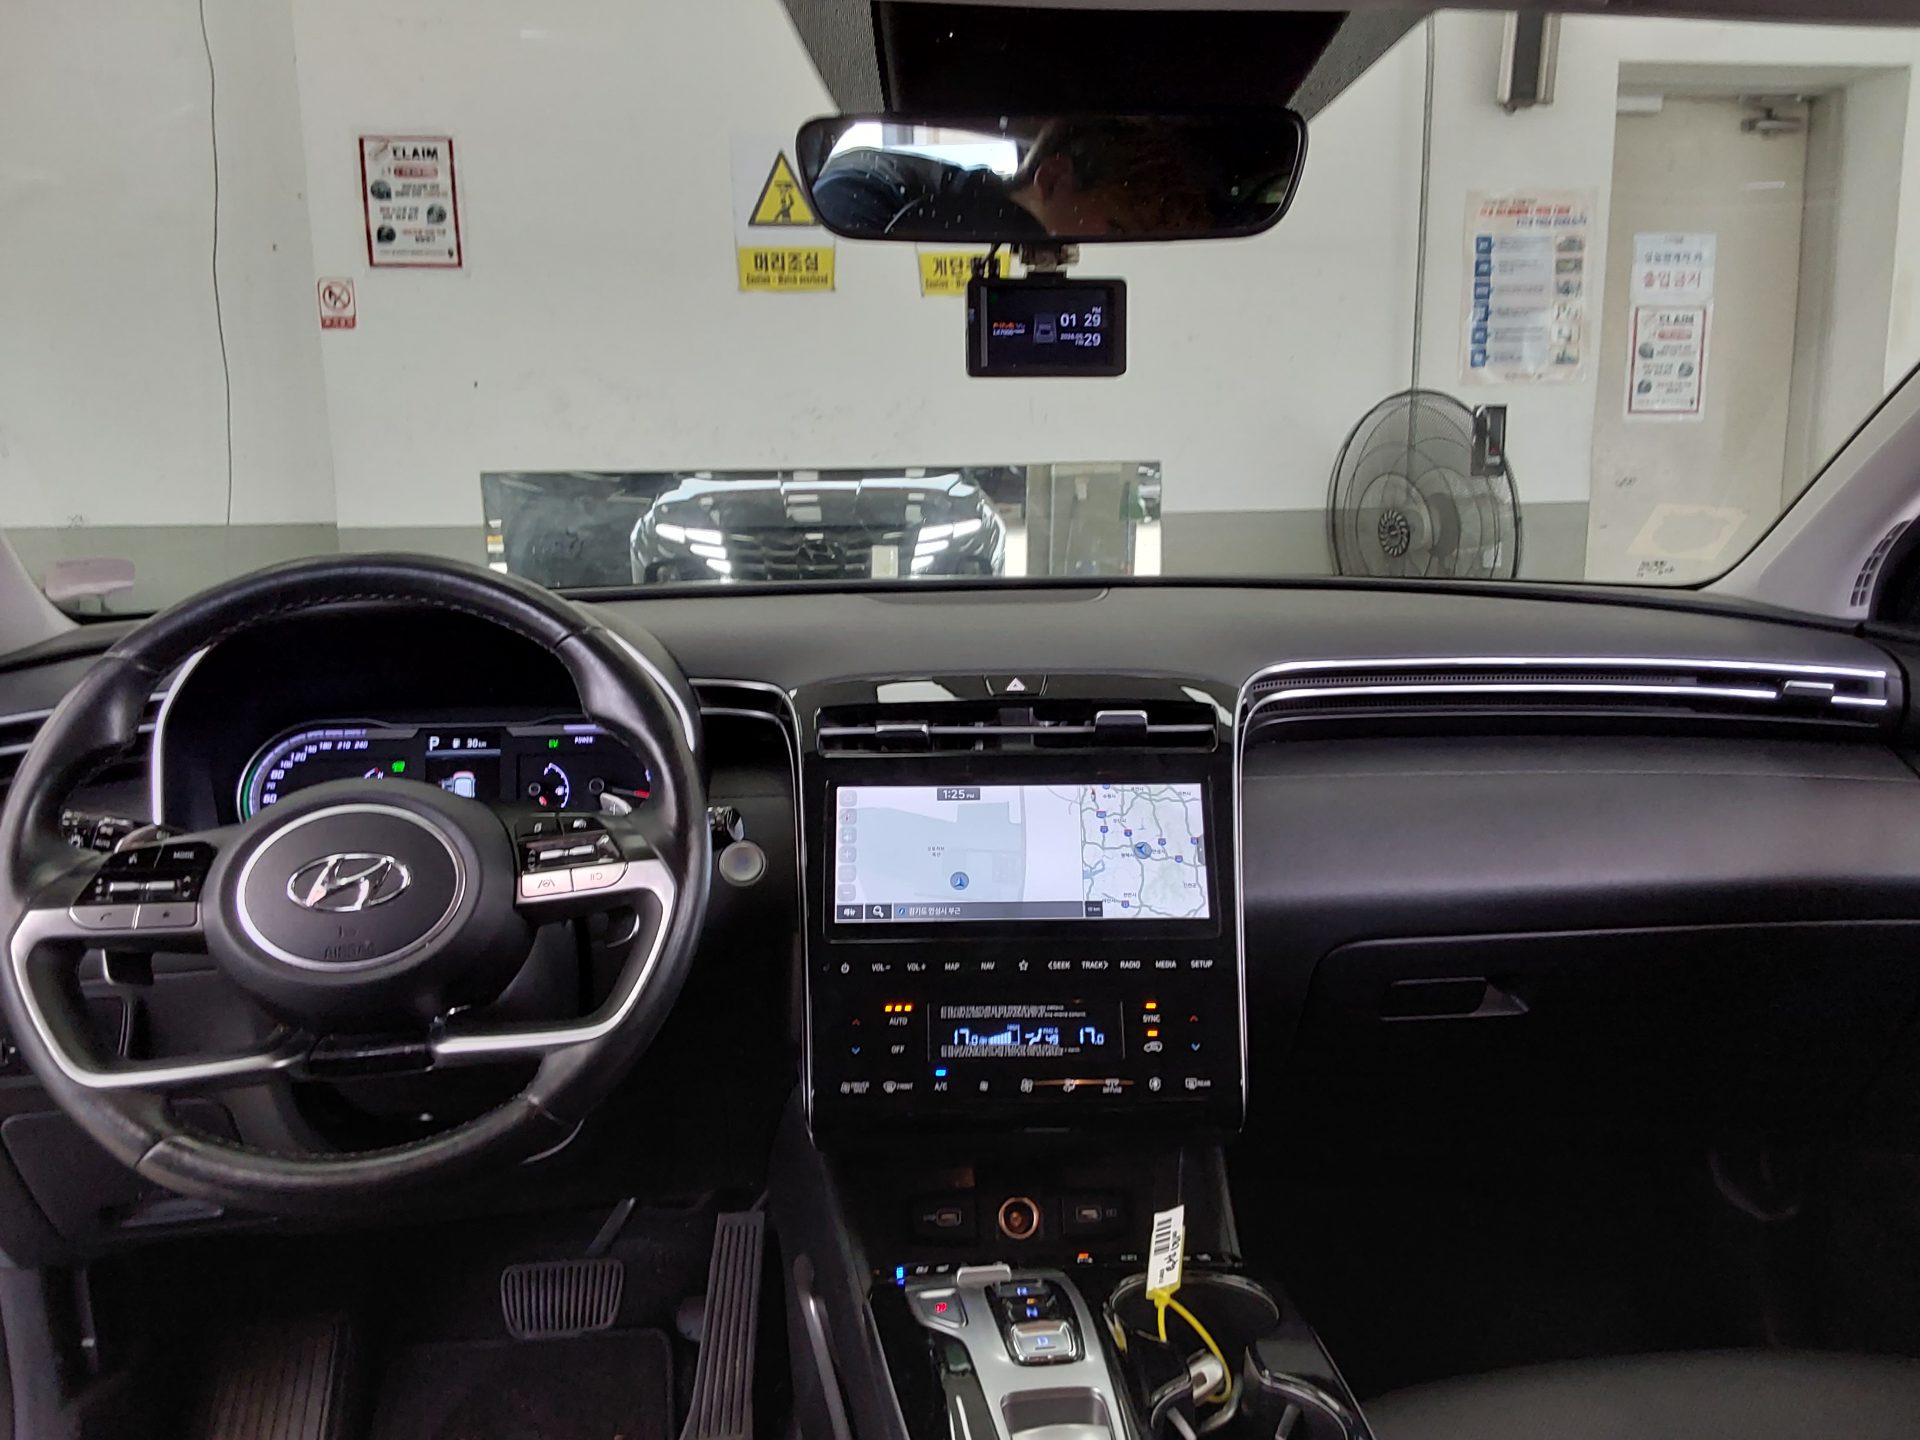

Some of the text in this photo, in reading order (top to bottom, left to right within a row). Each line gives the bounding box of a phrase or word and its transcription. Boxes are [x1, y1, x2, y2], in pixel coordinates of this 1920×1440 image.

[392, 146, 439, 161] CLAIM
[753, 252, 819, 273] 머리조심
[1060, 313, 1101, 327] 01 29
[1084, 333, 1101, 347] 29
[429, 735, 440, 751] P
[943, 789, 966, 799] 1:25
[944, 962, 961, 972] MAP
[980, 960, 996, 971] NAV
[1119, 960, 1141, 970] RADIO
[1155, 959, 1177, 969] MEDIA
[1190, 959, 1213, 969] SETUP
[889, 1016, 908, 1026] AUTO
[1142, 1014, 1161, 1023] SYNC
[891, 1045, 905, 1054] OFF
[934, 1081, 948, 1092] A/C
